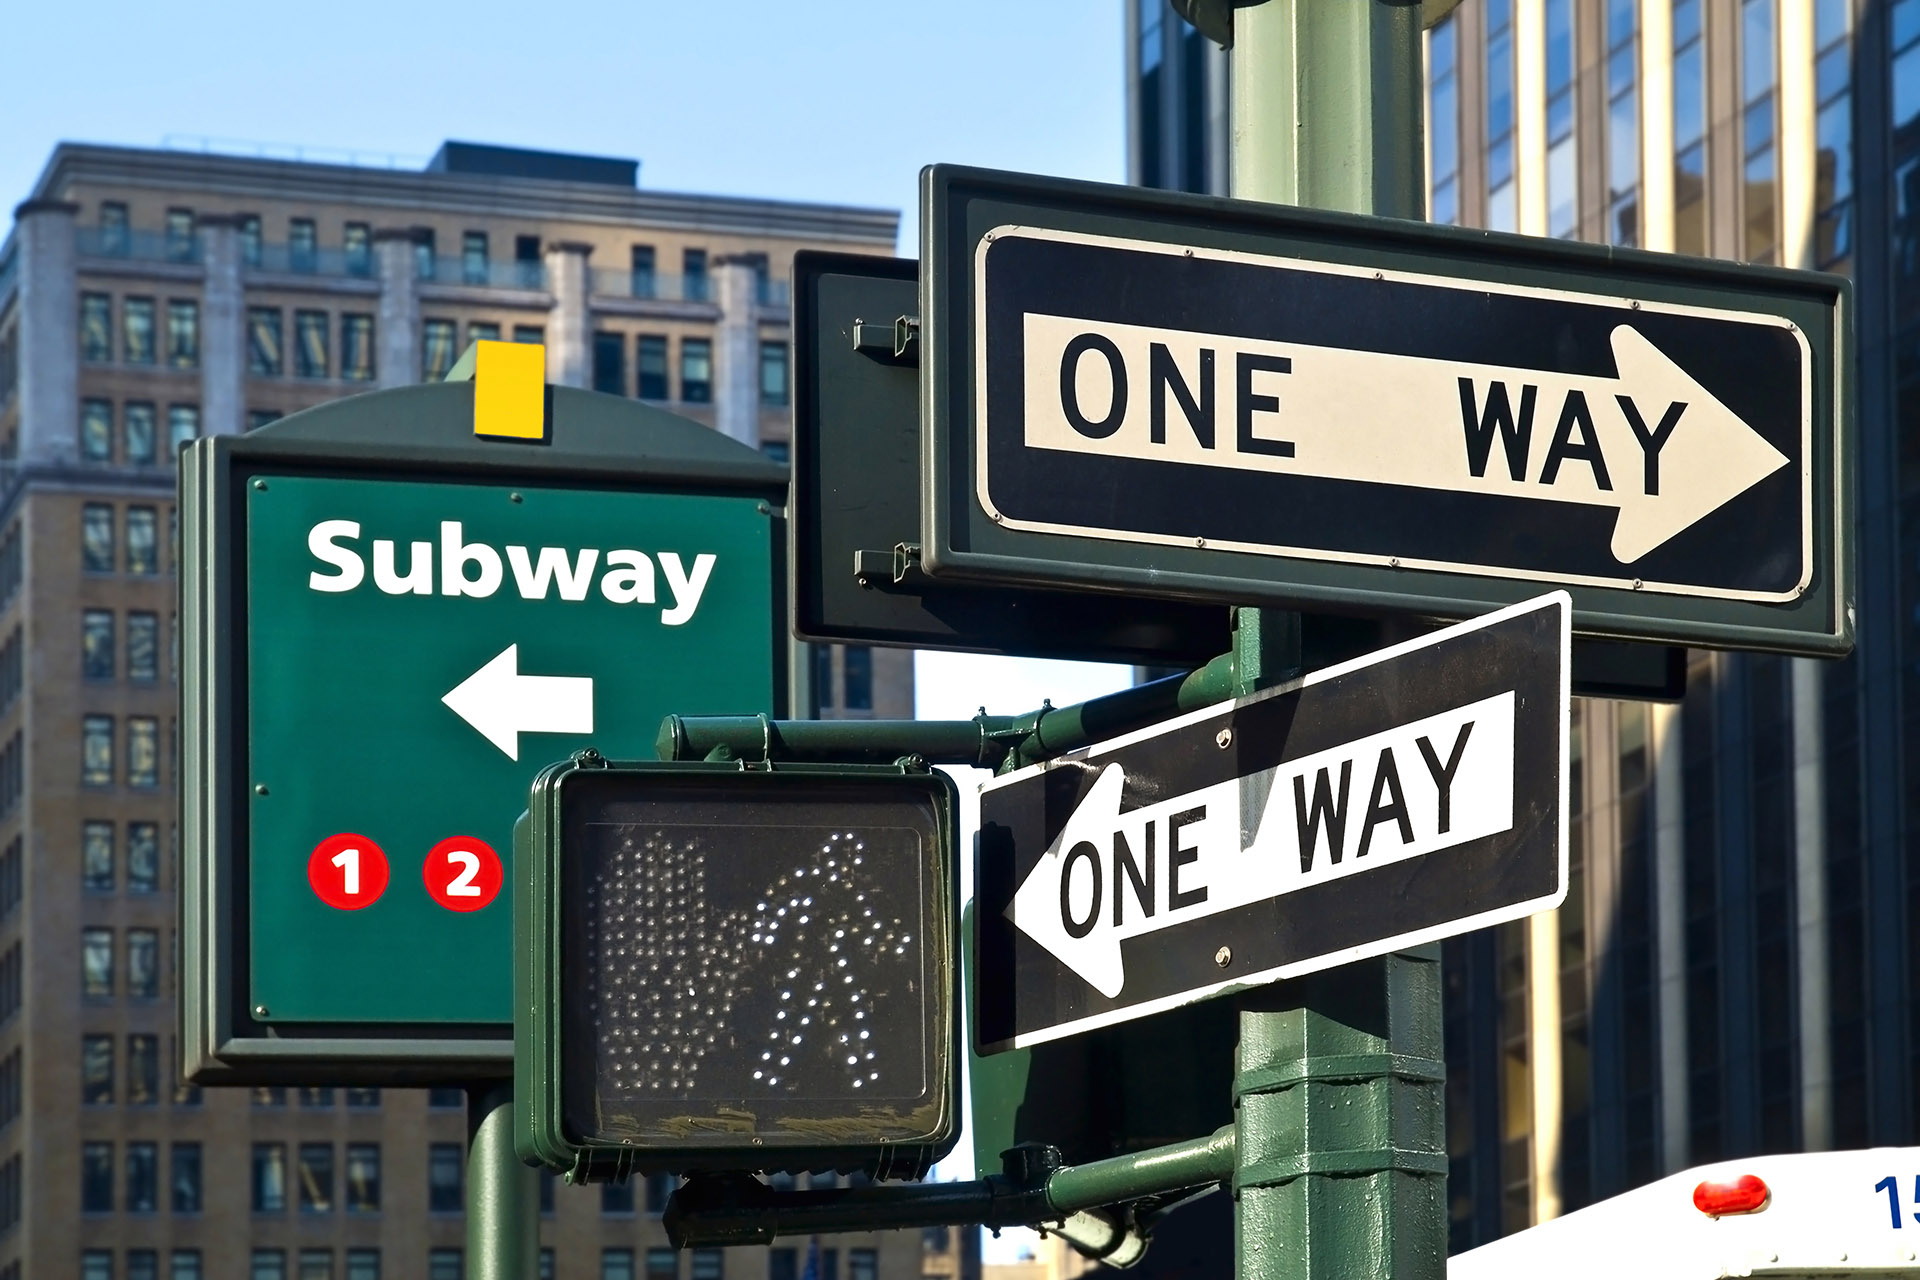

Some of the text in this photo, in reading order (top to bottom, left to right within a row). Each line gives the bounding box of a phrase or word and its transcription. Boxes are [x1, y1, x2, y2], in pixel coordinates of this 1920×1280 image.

[1059, 332, 1689, 497] ONE WAY
[308, 519, 717, 626] Subway
[331, 848, 481, 897] 1 2
[1059, 720, 1476, 939] ONE WAY
[1874, 1174, 1920, 1230] 1
